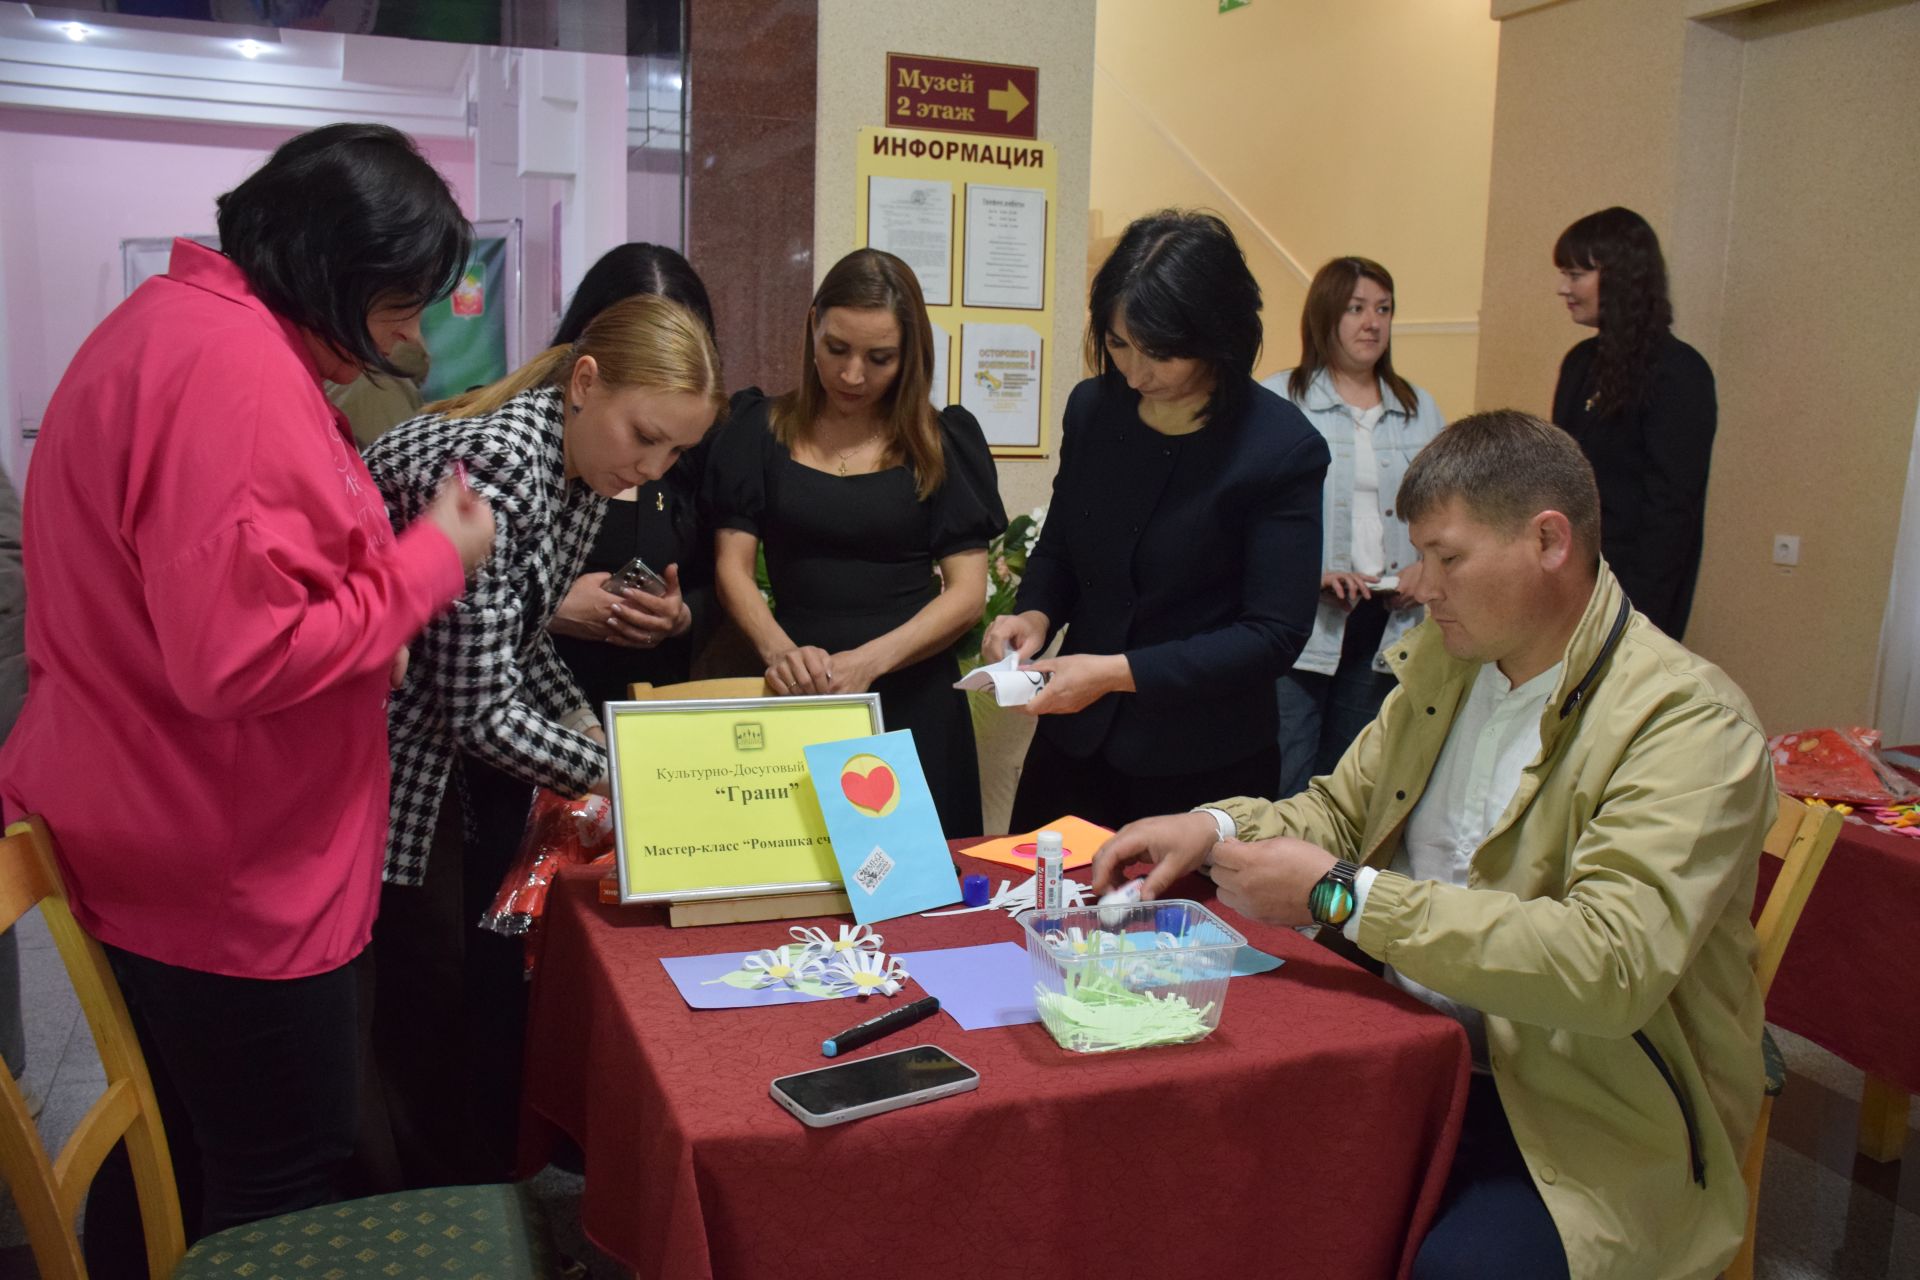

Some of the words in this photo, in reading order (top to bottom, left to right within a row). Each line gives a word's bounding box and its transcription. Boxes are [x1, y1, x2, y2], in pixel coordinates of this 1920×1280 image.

[897, 67, 975, 94] Музей
[896, 96, 911, 116] 2
[916, 100, 975, 122] этаж
[873, 135, 1044, 170] ИНФОРМАЦИЯ
[656, 760, 806, 782] Культурно-Досуговый
[644, 841, 740, 857] Мастер-класс
